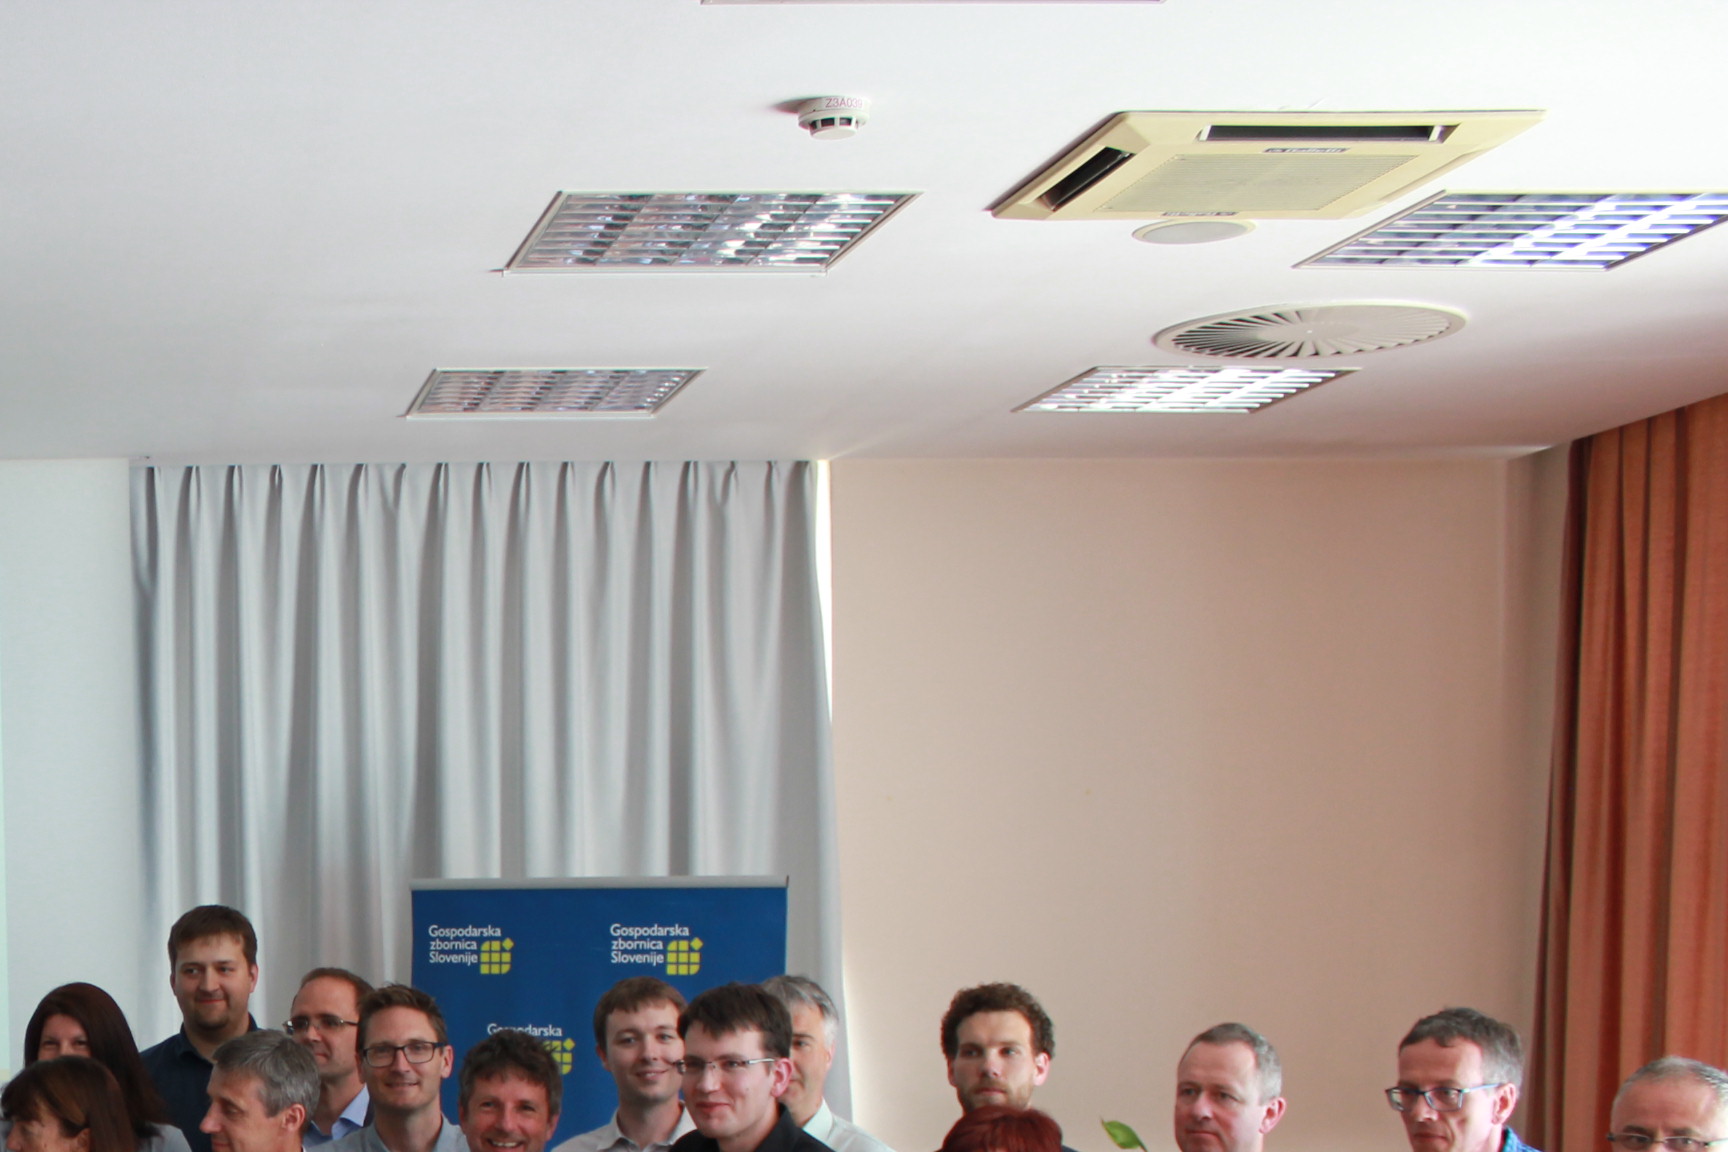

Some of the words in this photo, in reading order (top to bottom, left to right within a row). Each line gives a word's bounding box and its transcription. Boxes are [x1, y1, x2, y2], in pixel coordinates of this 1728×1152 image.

[428, 924, 502, 939] Gospodarska
[609, 923, 690, 939] Gospodarska
[429, 938, 477, 950] zbornica
[611, 938, 663, 950] zbornica
[428, 951, 478, 966] Slovenije
[610, 951, 665, 966] Slovenije
[487, 1023, 563, 1037] Godarska
